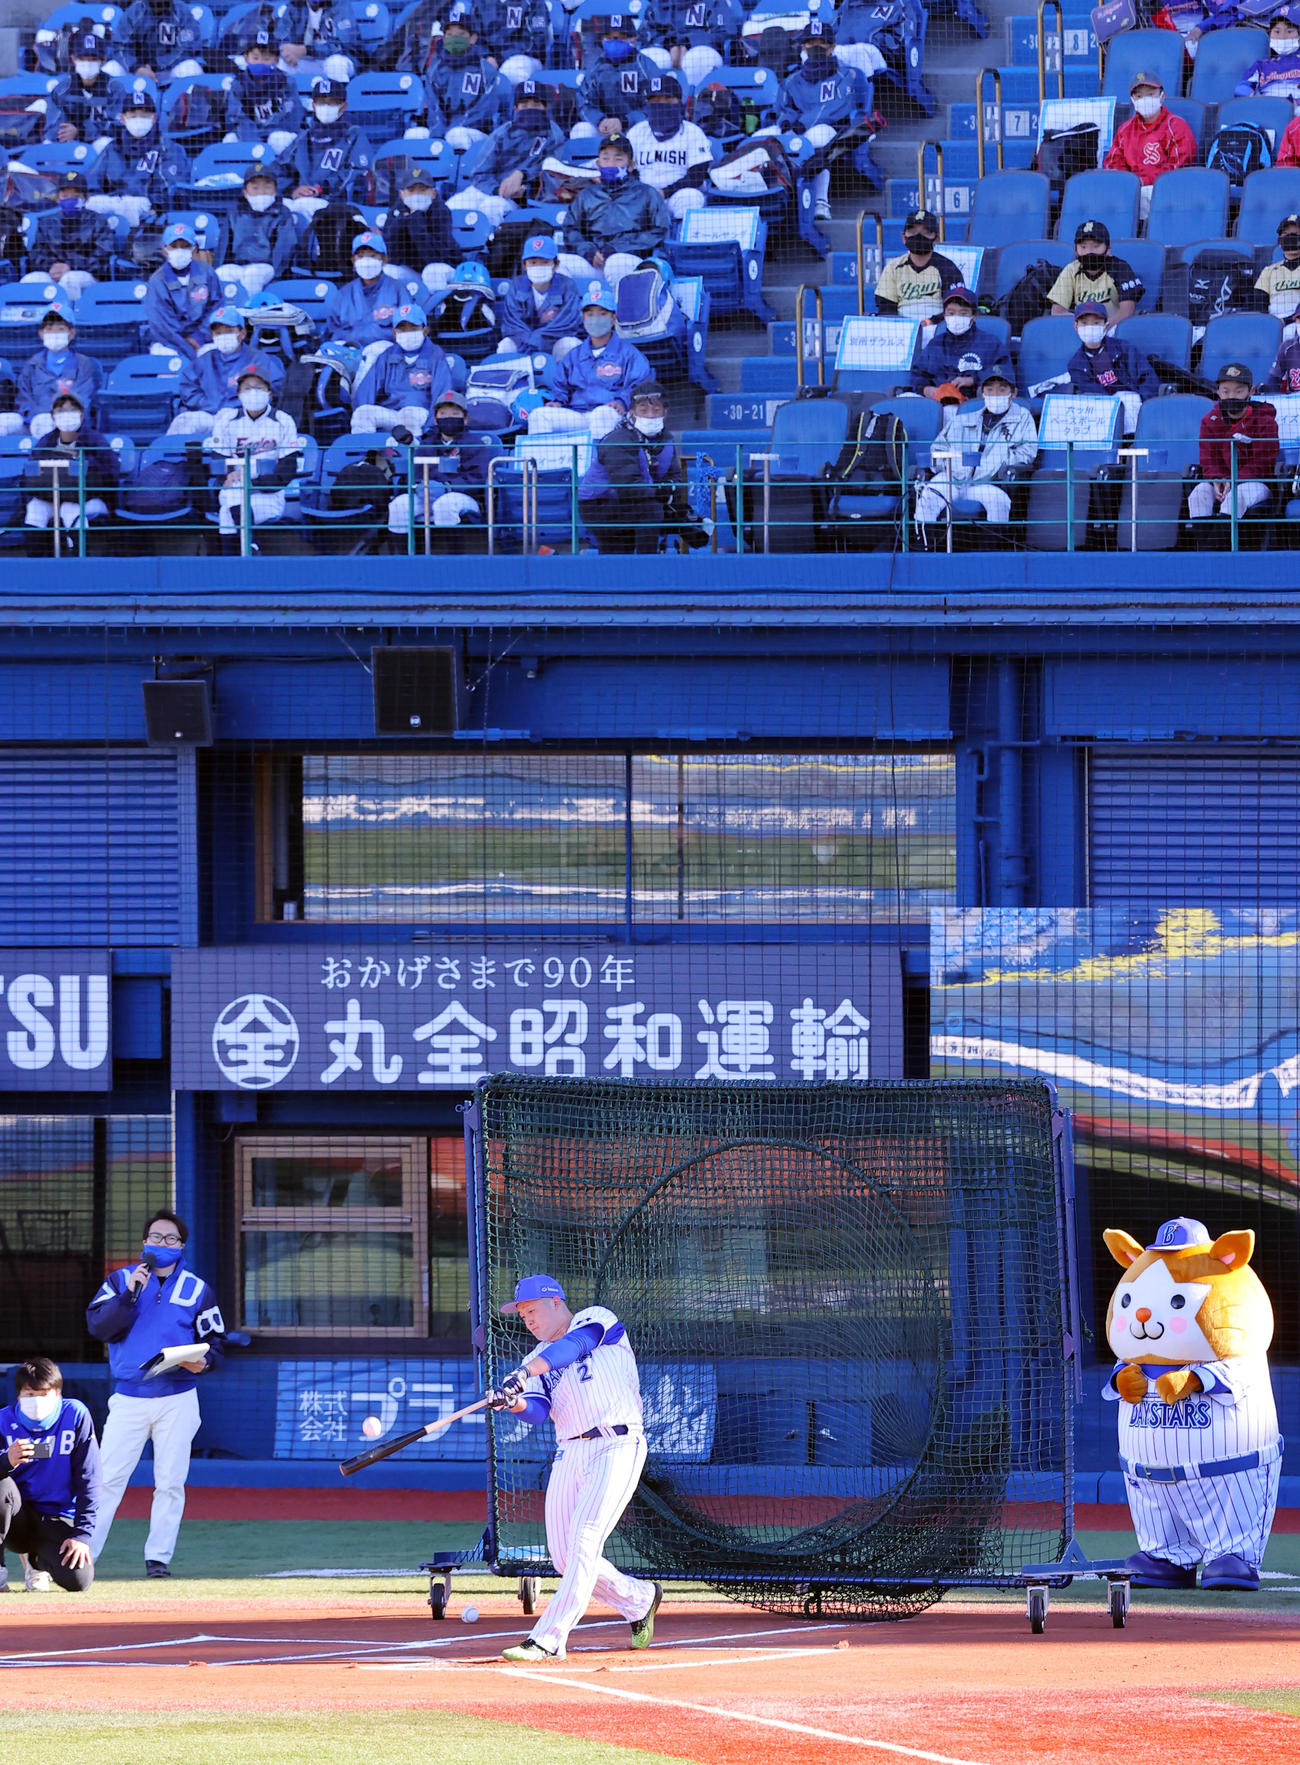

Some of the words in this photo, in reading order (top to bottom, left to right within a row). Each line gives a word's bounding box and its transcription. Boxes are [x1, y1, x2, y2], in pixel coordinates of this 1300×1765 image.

[1143, 142, 1161, 165] S
[320, 954, 636, 992] おかげさまで90年
[0, 973, 109, 1070] SU
[319, 997, 870, 1085] 丸全昭和運輸
[577, 1364, 593, 1383] 2
